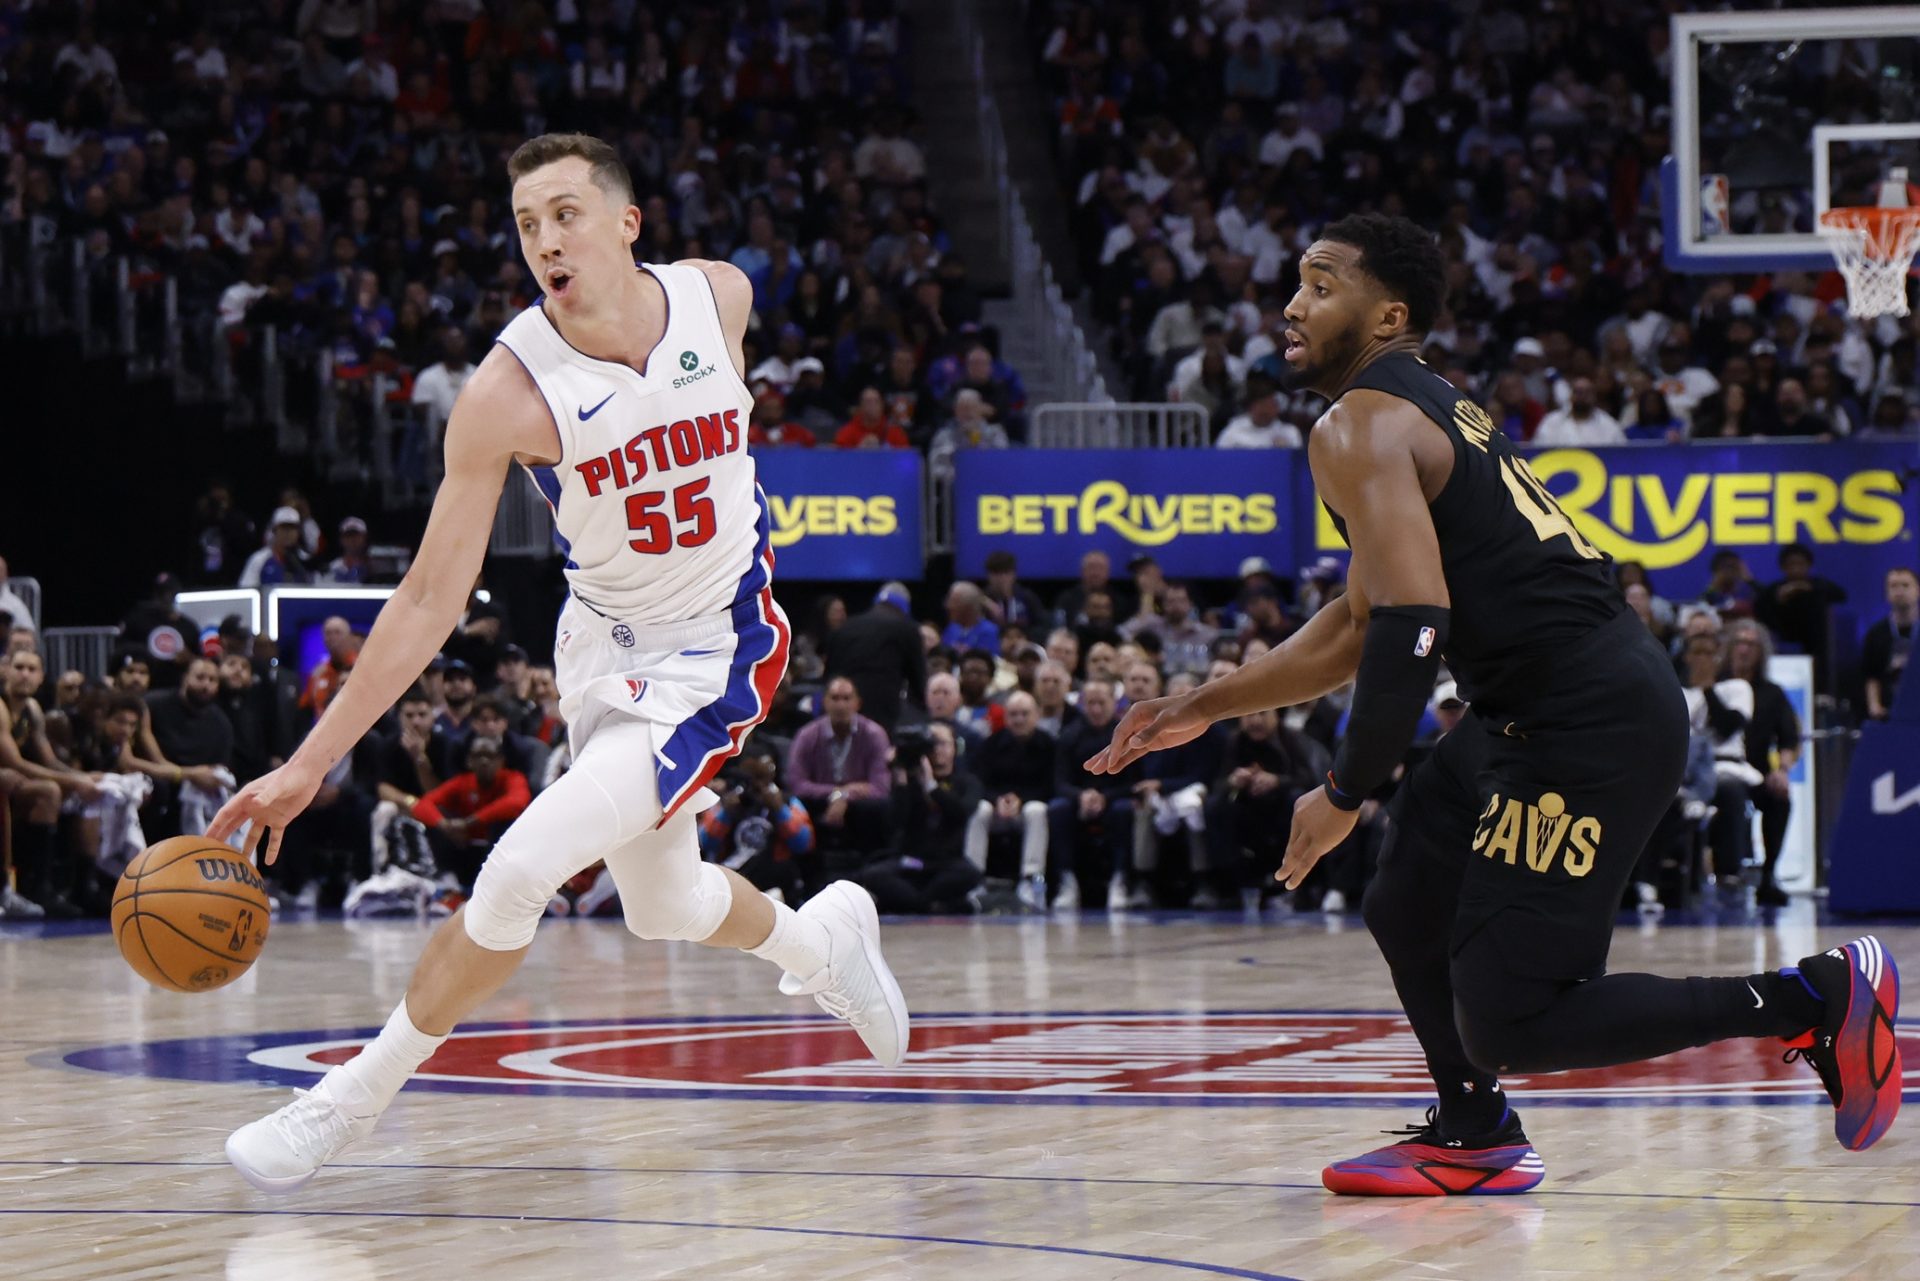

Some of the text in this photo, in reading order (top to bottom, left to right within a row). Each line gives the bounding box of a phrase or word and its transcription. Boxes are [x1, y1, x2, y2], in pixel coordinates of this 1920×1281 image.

[672, 363, 717, 389] StockX
[574, 408, 740, 498] PISTONS
[624, 475, 717, 555] 55
[768, 495, 898, 546] VERS
[978, 480, 1278, 546] BETRIVERS
[1499, 454, 1605, 560] 4
[1472, 792, 1601, 877] CAVS
